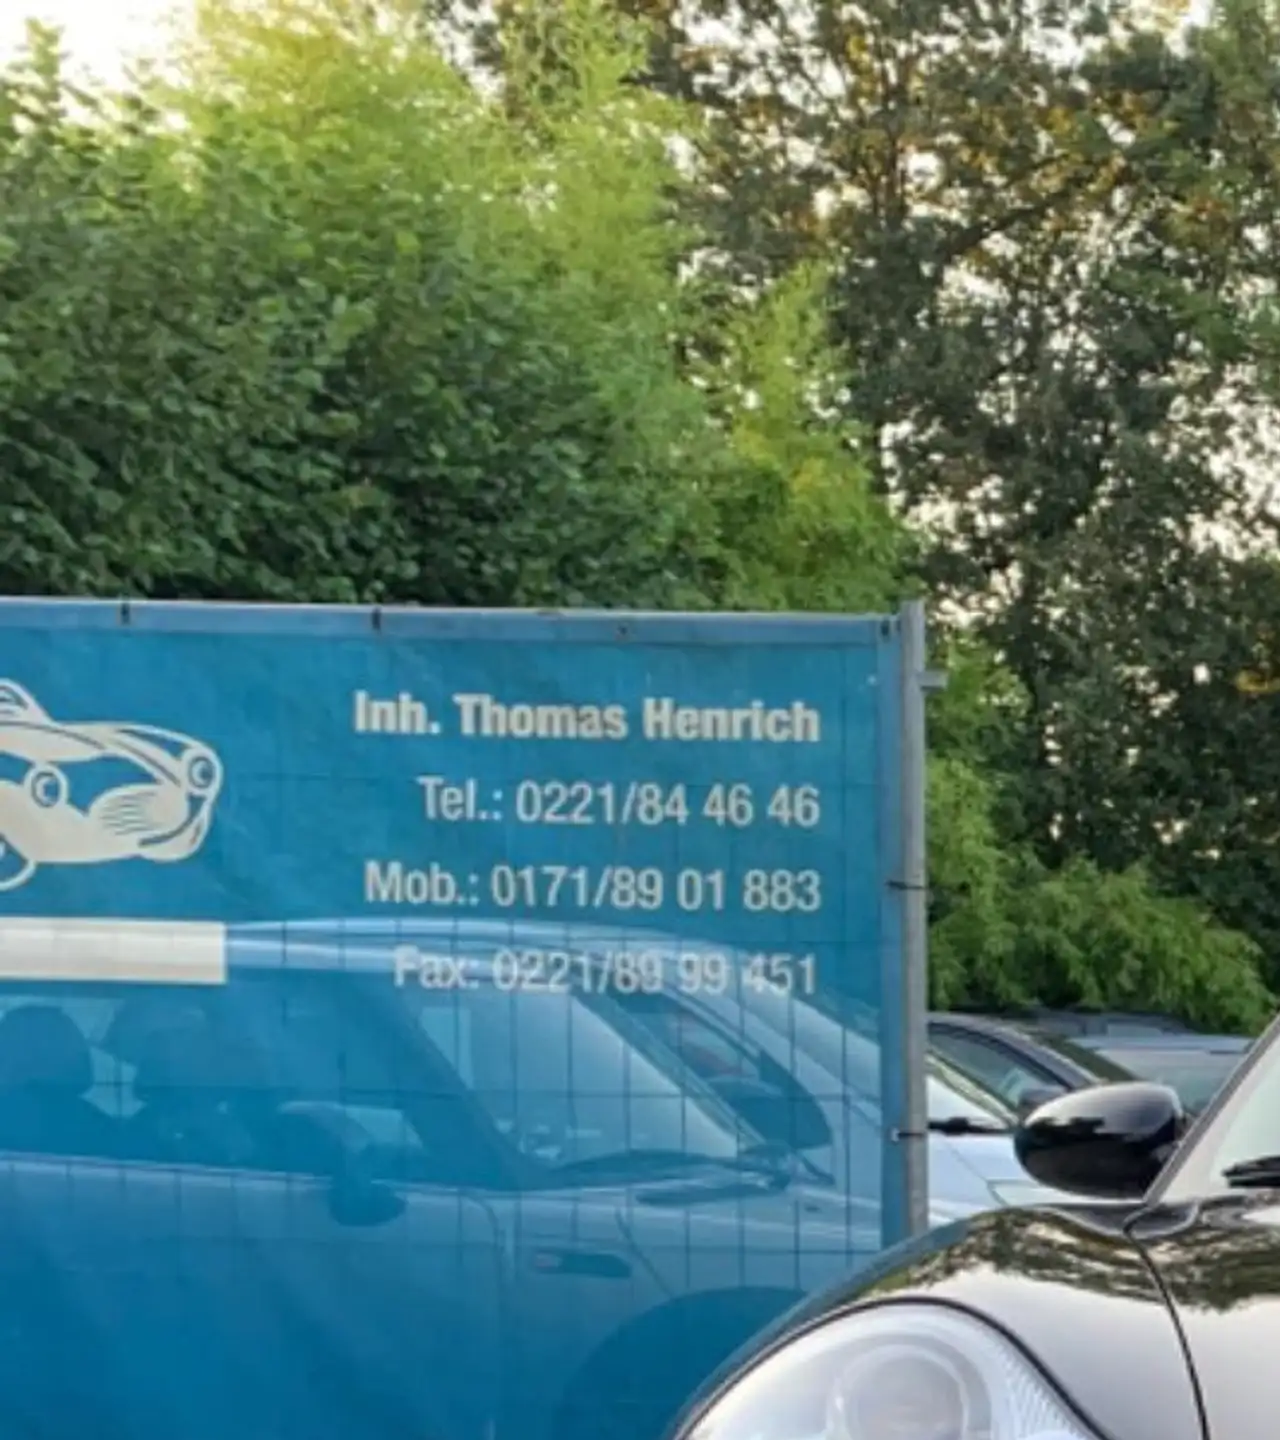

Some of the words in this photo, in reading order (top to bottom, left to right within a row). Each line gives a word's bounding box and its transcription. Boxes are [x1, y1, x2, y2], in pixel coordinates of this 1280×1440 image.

[353, 691, 441, 735] Inh.
[453, 693, 629, 741] Thomas
[642, 697, 821, 744] Henrich
[416, 774, 502, 821] Tel.:
[516, 780, 690, 827] 0221/84
[702, 782, 754, 828] 46
[766, 783, 821, 829] 46
[364, 860, 480, 906] Mob.:
[490, 864, 665, 910] 0171/89
[676, 867, 725, 912] 01
[742, 868, 822, 913] 883
[394, 944, 480, 990] Fax:
[491, 949, 665, 994] 0221/89
[676, 951, 730, 995] 99
[741, 951, 817, 996] 451
